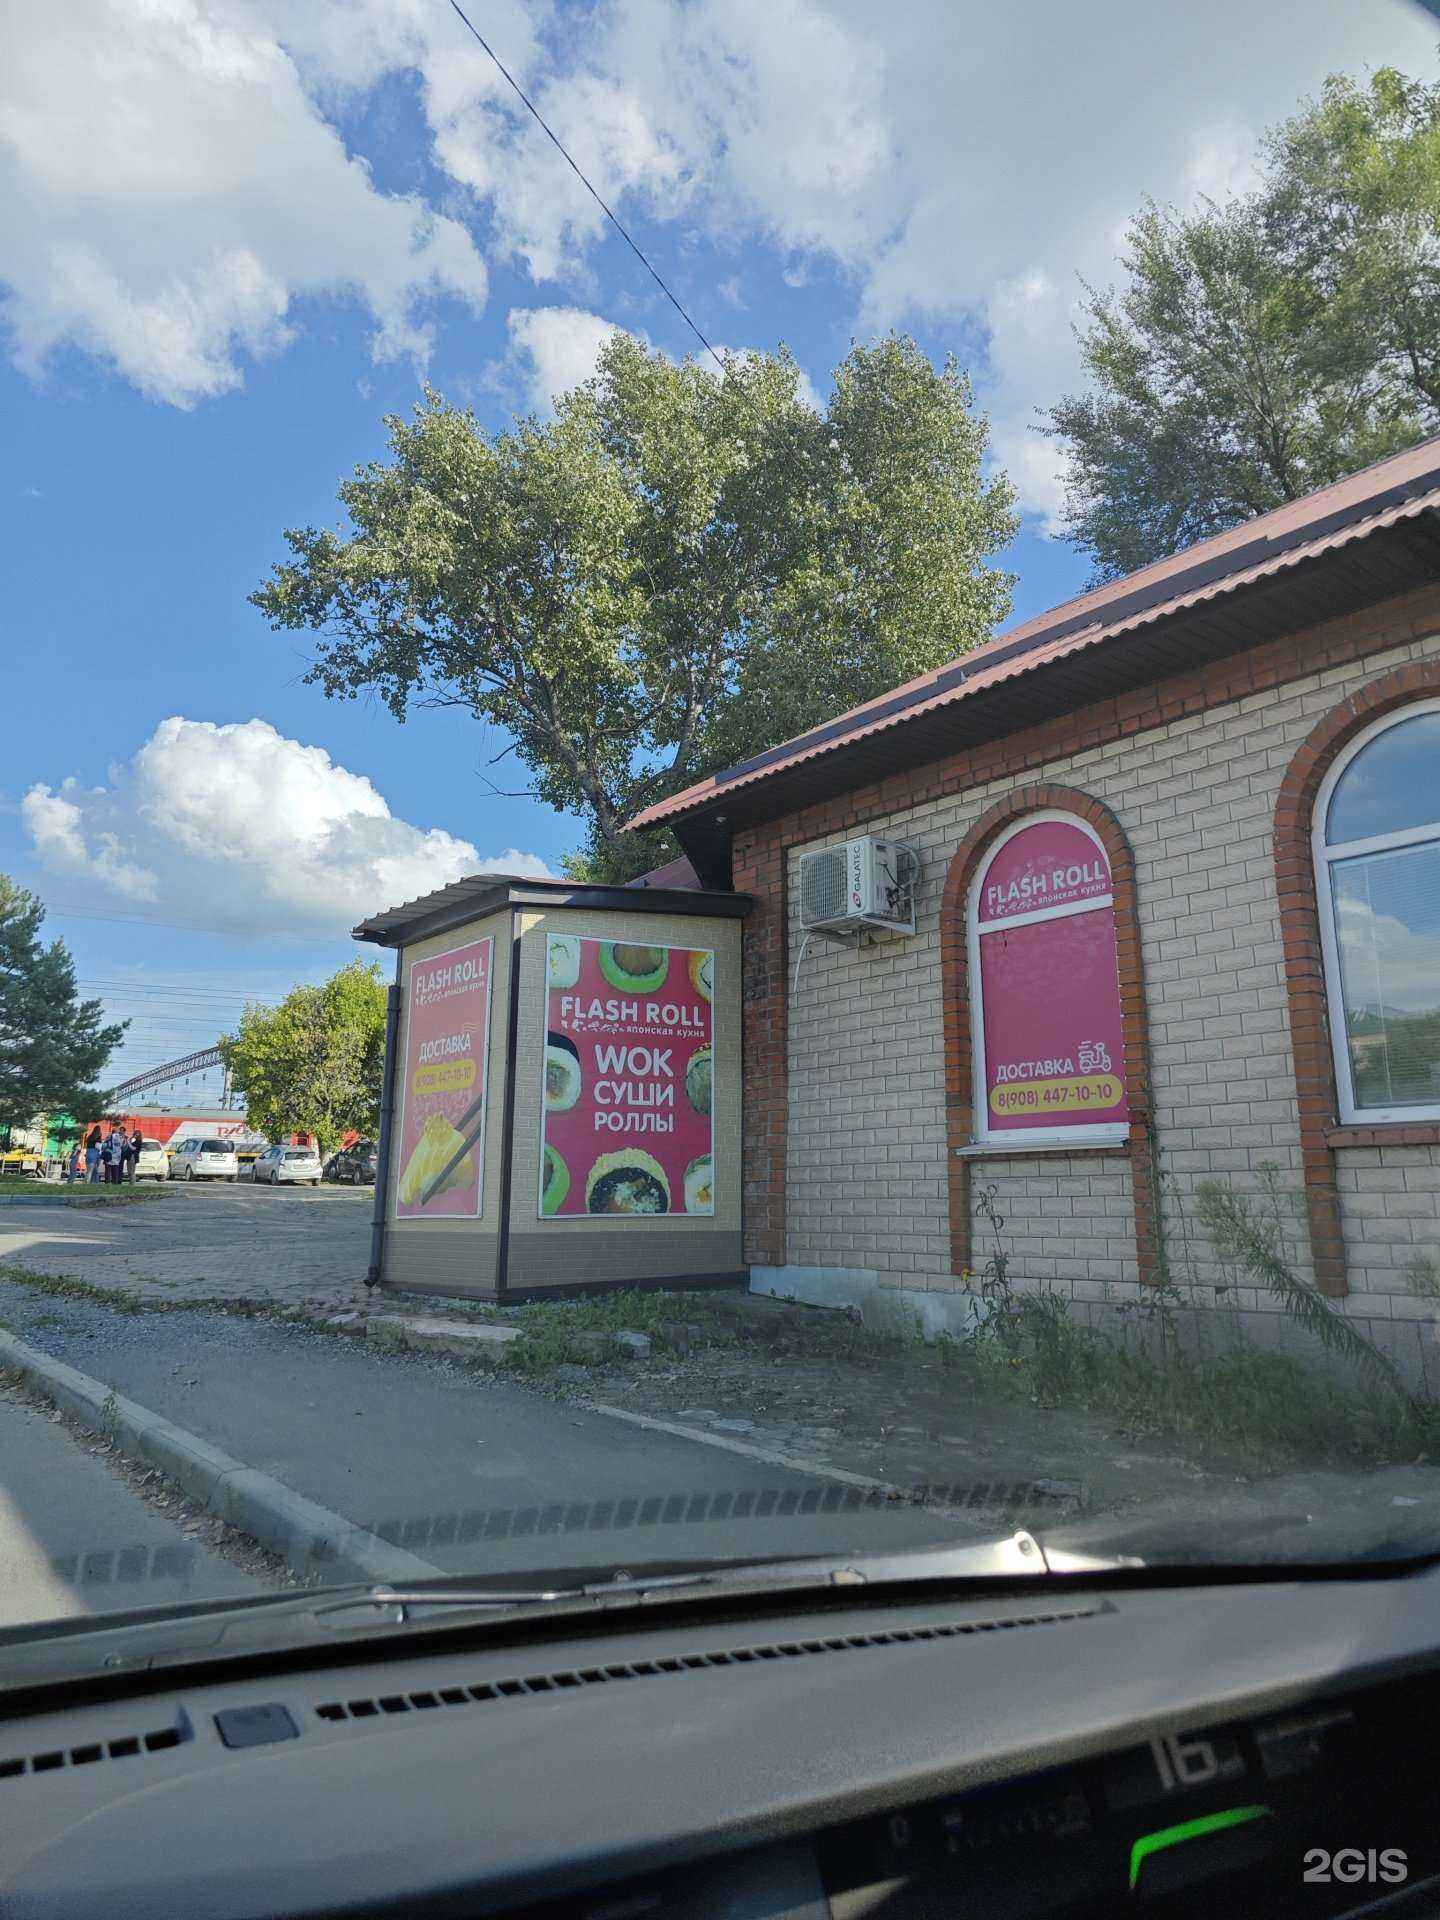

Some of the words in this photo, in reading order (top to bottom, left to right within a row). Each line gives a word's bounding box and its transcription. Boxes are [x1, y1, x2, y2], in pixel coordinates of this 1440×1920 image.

[988, 873, 1047, 906] FLASH
[1052, 860, 1105, 891] ROLL
[416, 966, 452, 994] FLASH
[454, 958, 485, 983] ROLL
[561, 996, 638, 1022] FLASH
[646, 1003, 705, 1027] ROLL
[627, 1025, 673, 1036] японская
[677, 1027, 705, 1038] кухня
[419, 1032, 471, 1063] ДОСТАВКА
[594, 1044, 674, 1077] WOK
[996, 1058, 1075, 1083] ДОСТАВКА
[594, 1080, 674, 1106] СУШИ
[998, 1089, 1039, 1108] 8(908)
[1043, 1084, 1112, 1103] 447-10-10
[594, 1111, 674, 1132] РОЛЛЫ
